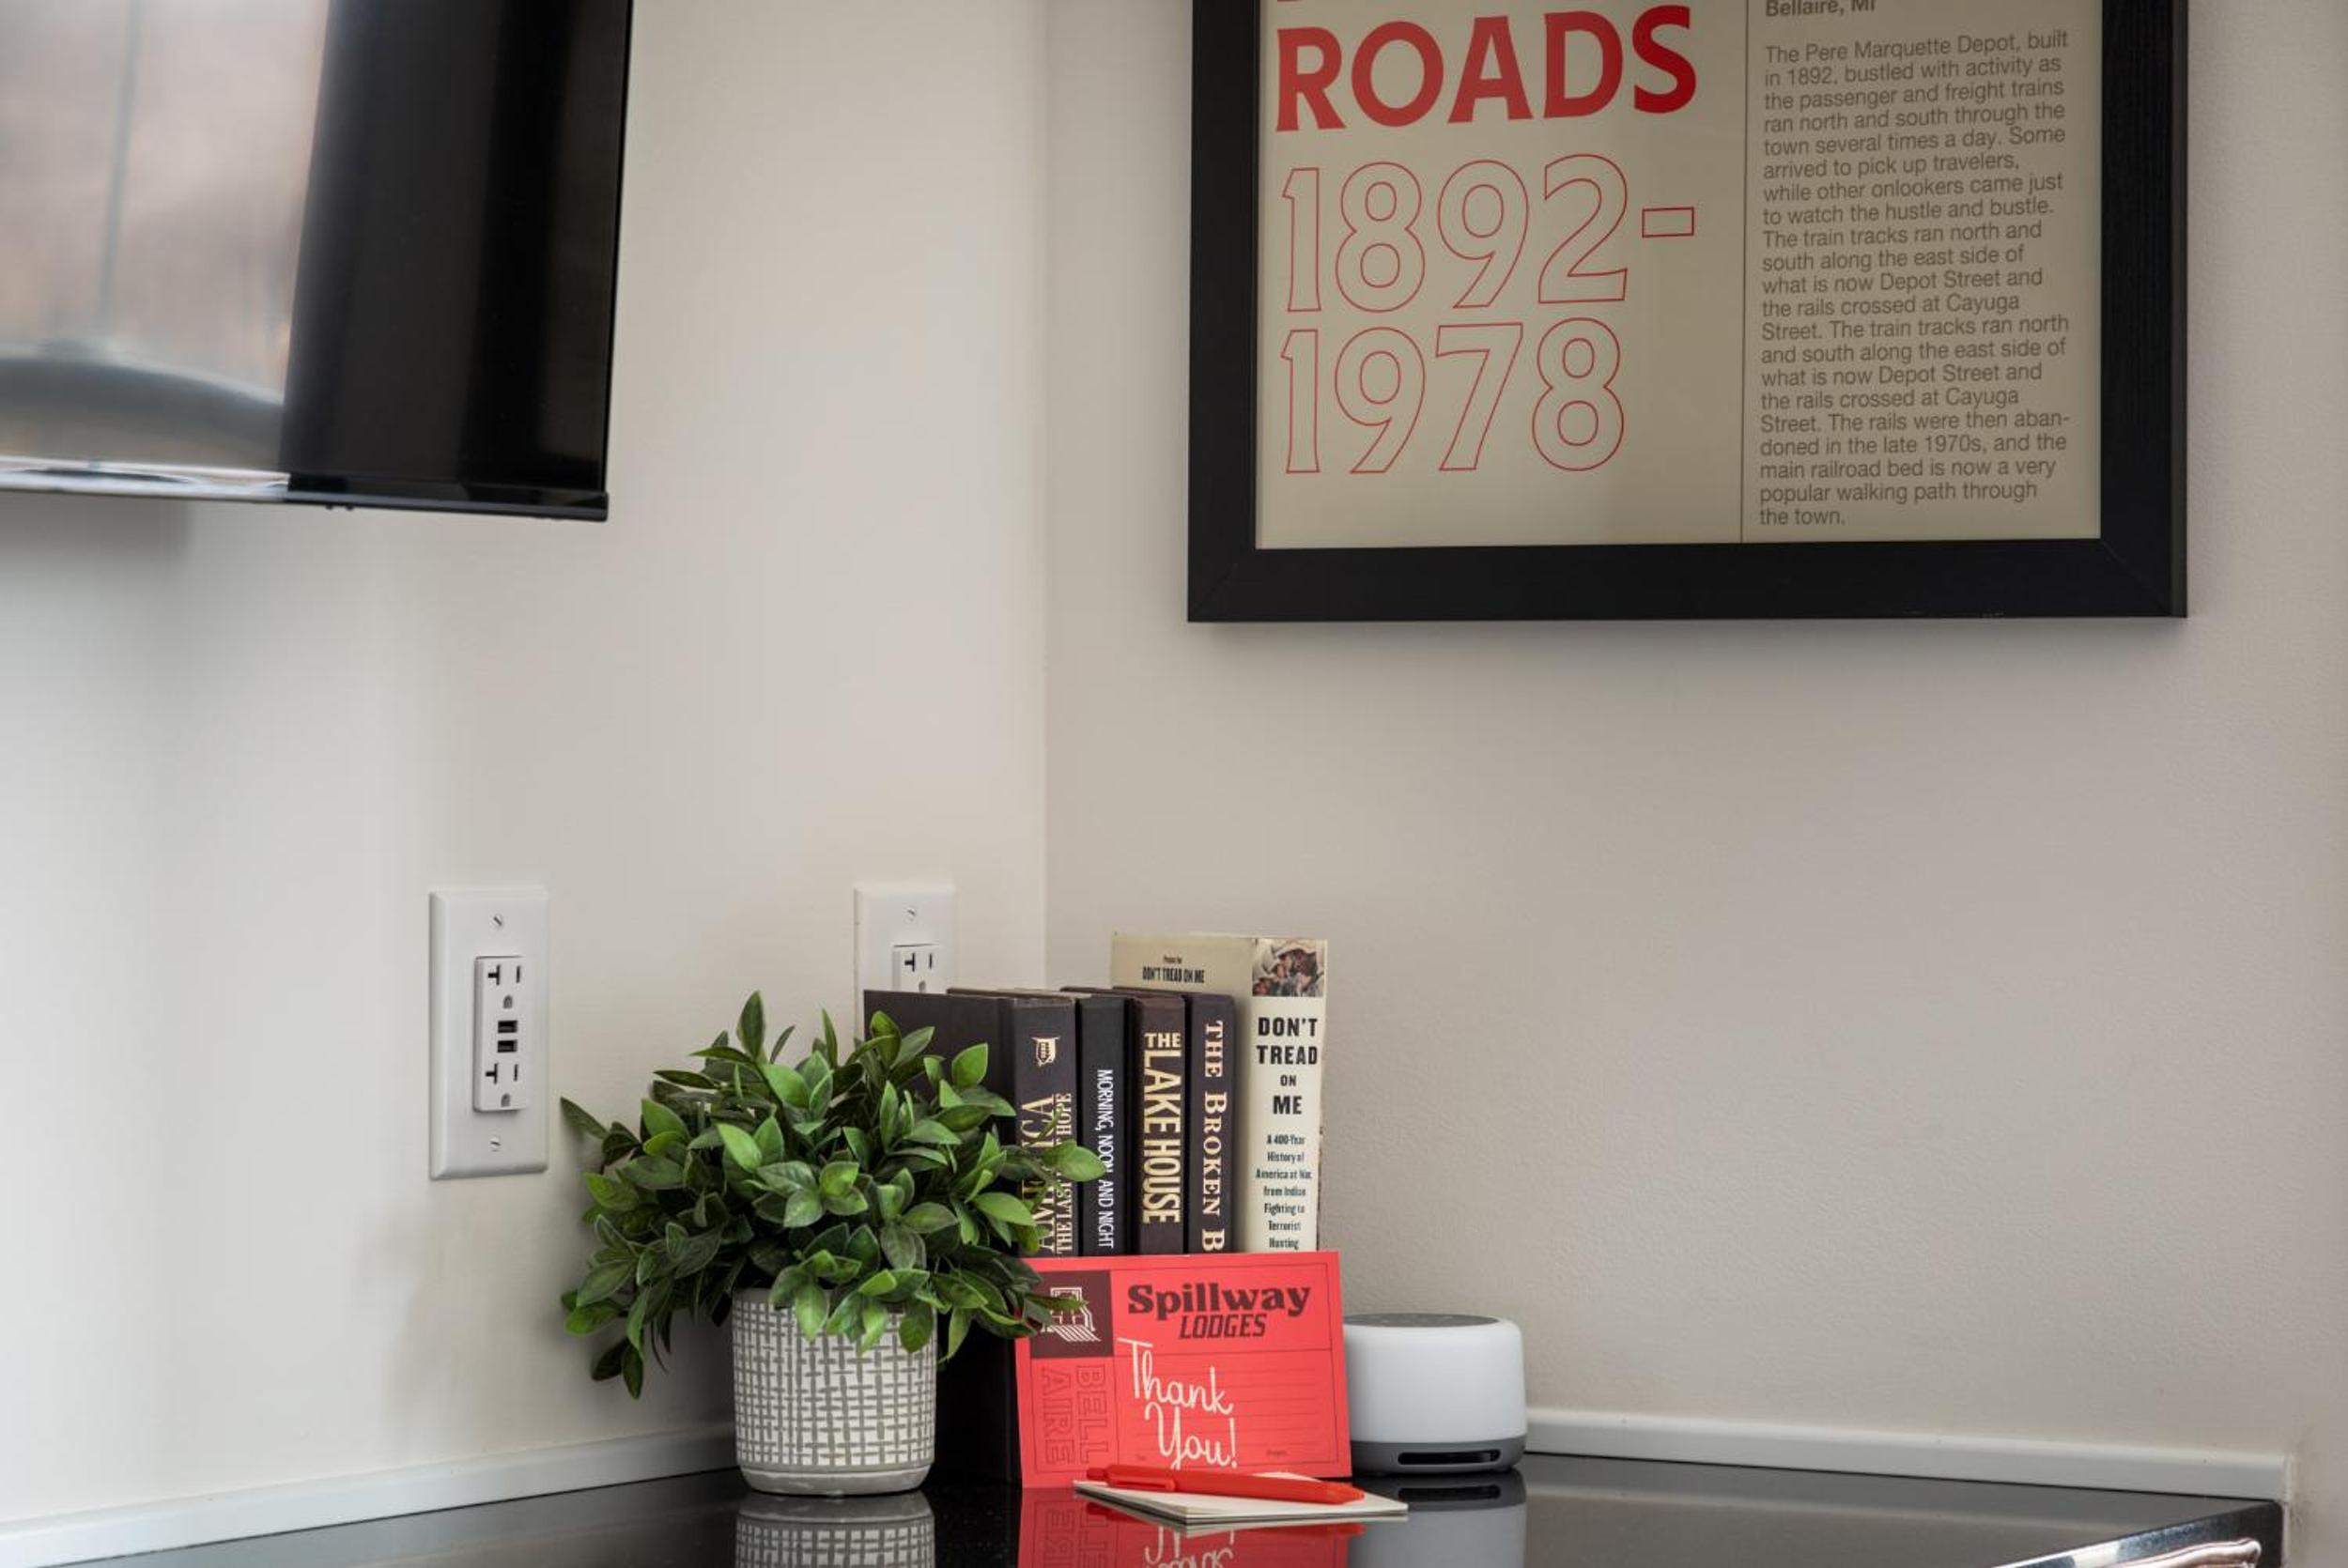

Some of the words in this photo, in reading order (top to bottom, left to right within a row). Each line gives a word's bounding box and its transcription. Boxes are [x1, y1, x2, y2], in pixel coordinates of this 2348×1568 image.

[1766, 0, 1845, 16] Bellaire,
[1851, 0, 1876, 11] MI
[1766, 45, 1800, 63] The
[1805, 44, 1848, 61] Pere
[1854, 38, 1952, 61] Marquette
[2027, 31, 2068, 49] built
[1275, 5, 1697, 132] ROADS
[1765, 71, 1781, 86] in
[1844, 63, 1914, 83] bustled
[1920, 61, 1959, 79] with
[1965, 59, 2033, 78] activity
[2038, 59, 2062, 73] as
[1764, 93, 1795, 110] the
[1800, 90, 1898, 113] passenger
[1903, 85, 1939, 102] and
[1944, 82, 2006, 103] freight
[2011, 81, 2064, 98] trains
[1765, 118, 1794, 132] ran
[1800, 113, 1848, 131] north
[1854, 111, 1890, 129] and
[1895, 108, 1948, 127] south
[1954, 104, 2028, 126] through
[2034, 102, 2065, 120] the
[1764, 140, 1810, 156] town
[1815, 134, 1881, 154] several
[1888, 134, 1939, 150] times
[1944, 135, 1956, 148] a
[1961, 131, 2002, 151] day.
[2008, 129, 2065, 146] Some
[1763, 160, 1828, 178] arrived
[1832, 161, 1852, 176] to
[1858, 157, 1897, 179] pick
[1902, 160, 1927, 177] up
[1763, 183, 1812, 201] while
[1816, 181, 1866, 199] other
[1871, 177, 1964, 196] onlookers
[1970, 177, 2023, 192] came
[2030, 174, 2063, 194] just
[1763, 208, 1782, 224] to
[1787, 205, 1844, 223] watch
[1850, 204, 1879, 222] the
[1885, 202, 1942, 221] hustle
[1947, 200, 1984, 218] and
[1990, 198, 2053, 217] bustle.
[1281, 154, 1694, 313] 1892-
[1762, 230, 1799, 248] The
[1802, 230, 1845, 246] train
[1850, 226, 1908, 245] tracks
[1913, 228, 1944, 242] ran
[1950, 223, 2000, 241] north
[2005, 221, 2042, 238] and
[1763, 253, 1814, 270] south
[1820, 252, 1872, 271] along
[1878, 250, 1908, 267] the
[1914, 249, 1954, 266] east
[1960, 247, 2000, 264] side
[2005, 245, 2024, 263] of
[1762, 277, 1807, 294] what
[1813, 277, 1829, 292] is
[1833, 278, 1874, 292] now
[1880, 273, 1937, 294] Depot
[1943, 271, 2000, 288] Street
[2006, 269, 2043, 286] and
[1762, 300, 1792, 317] the
[1797, 299, 1835, 316] rails
[1840, 296, 1917, 315] crossed
[1922, 297, 1940, 313] at
[1945, 295, 2020, 315] Cayuga
[1762, 324, 1822, 341] Street.
[1831, 322, 1864, 339] The
[1869, 322, 1911, 338] train
[1918, 318, 1976, 336] tracks
[1982, 321, 2013, 335] ran
[2018, 316, 2069, 334] north
[1761, 346, 1797, 363] and
[1802, 345, 1855, 362] south
[1860, 344, 1912, 364] along
[1918, 342, 1950, 360] the
[1954, 342, 1996, 359] east
[2000, 340, 2042, 357] side
[2047, 339, 2066, 356] of
[1761, 369, 1806, 386] what
[1813, 369, 1828, 385] is
[1833, 371, 1873, 384] now
[1878, 366, 1936, 387] Depot
[1942, 365, 2000, 382] Street
[2005, 363, 2042, 380] and
[1280, 317, 1624, 474] 1978
[1760, 392, 1791, 409] the
[1796, 392, 1834, 408] rails
[1839, 390, 1915, 407] crossed
[1921, 391, 1939, 407] at
[1945, 389, 2019, 409] Cayuga
[1760, 416, 1822, 433] Street.
[1828, 414, 1863, 432] The
[1869, 413, 1908, 431] rails
[1913, 416, 1960, 430] were
[1965, 411, 2008, 429] then
[2014, 410, 2070, 428] aban-
[1759, 438, 1820, 456] doned
[1825, 439, 1842, 454] in
[1847, 438, 1877, 454] the
[1883, 437, 1919, 453] late
[1924, 436, 1987, 454] 1970s,
[1993, 434, 2031, 452] and
[2036, 434, 2067, 451] the
[1760, 463, 1805, 479] main
[1811, 460, 1881, 478] railroad
[1887, 460, 1923, 477] bed
[1929, 461, 1946, 476] is
[1951, 463, 1992, 476] now
[1997, 462, 2010, 475] a
[2015, 461, 2057, 479] very
[1760, 484, 1831, 506] popular
[1837, 484, 1908, 504] walking
[1914, 483, 1955, 504] path
[1963, 482, 2037, 503] through
[1758, 508, 1789, 525] the
[1794, 509, 1846, 525] town.
[1258, 1017, 1318, 1037] DON'T
[1145, 1033, 1182, 1048] THE
[1204, 1021, 1224, 1077] THE
[1256, 1045, 1318, 1065] TREAD
[1143, 1050, 1182, 1133] LAKE
[1280, 1075, 1296, 1086] ON
[1094, 1069, 1114, 1130] MORNING,
[1273, 1096, 1303, 1115] ME
[1055, 1093, 1073, 1135] HOPE
[1266, 1135, 1273, 1145] A
[1202, 1091, 1228, 1217] BROKEN
[1267, 1152, 1296, 1164] History
[1021, 1094, 1055, 1253] AMICA
[1142, 1139, 1182, 1223] HOUSE
[1098, 1179, 1114, 1207] AND
[1264, 1203, 1296, 1216] Fighting
[1056, 1222, 1073, 1253] THE
[1098, 1211, 1114, 1249] NIGHT
[1268, 1220, 1302, 1231] Terrorist
[1127, 1283, 1311, 1321] Spillway
[1179, 1314, 1267, 1339] LODGES
[1117, 1337, 1234, 1415] Thank
[1042, 1366, 1075, 1465] AIRE
[1077, 1364, 1109, 1465] BELL
[1144, 1401, 1238, 1470] You!
